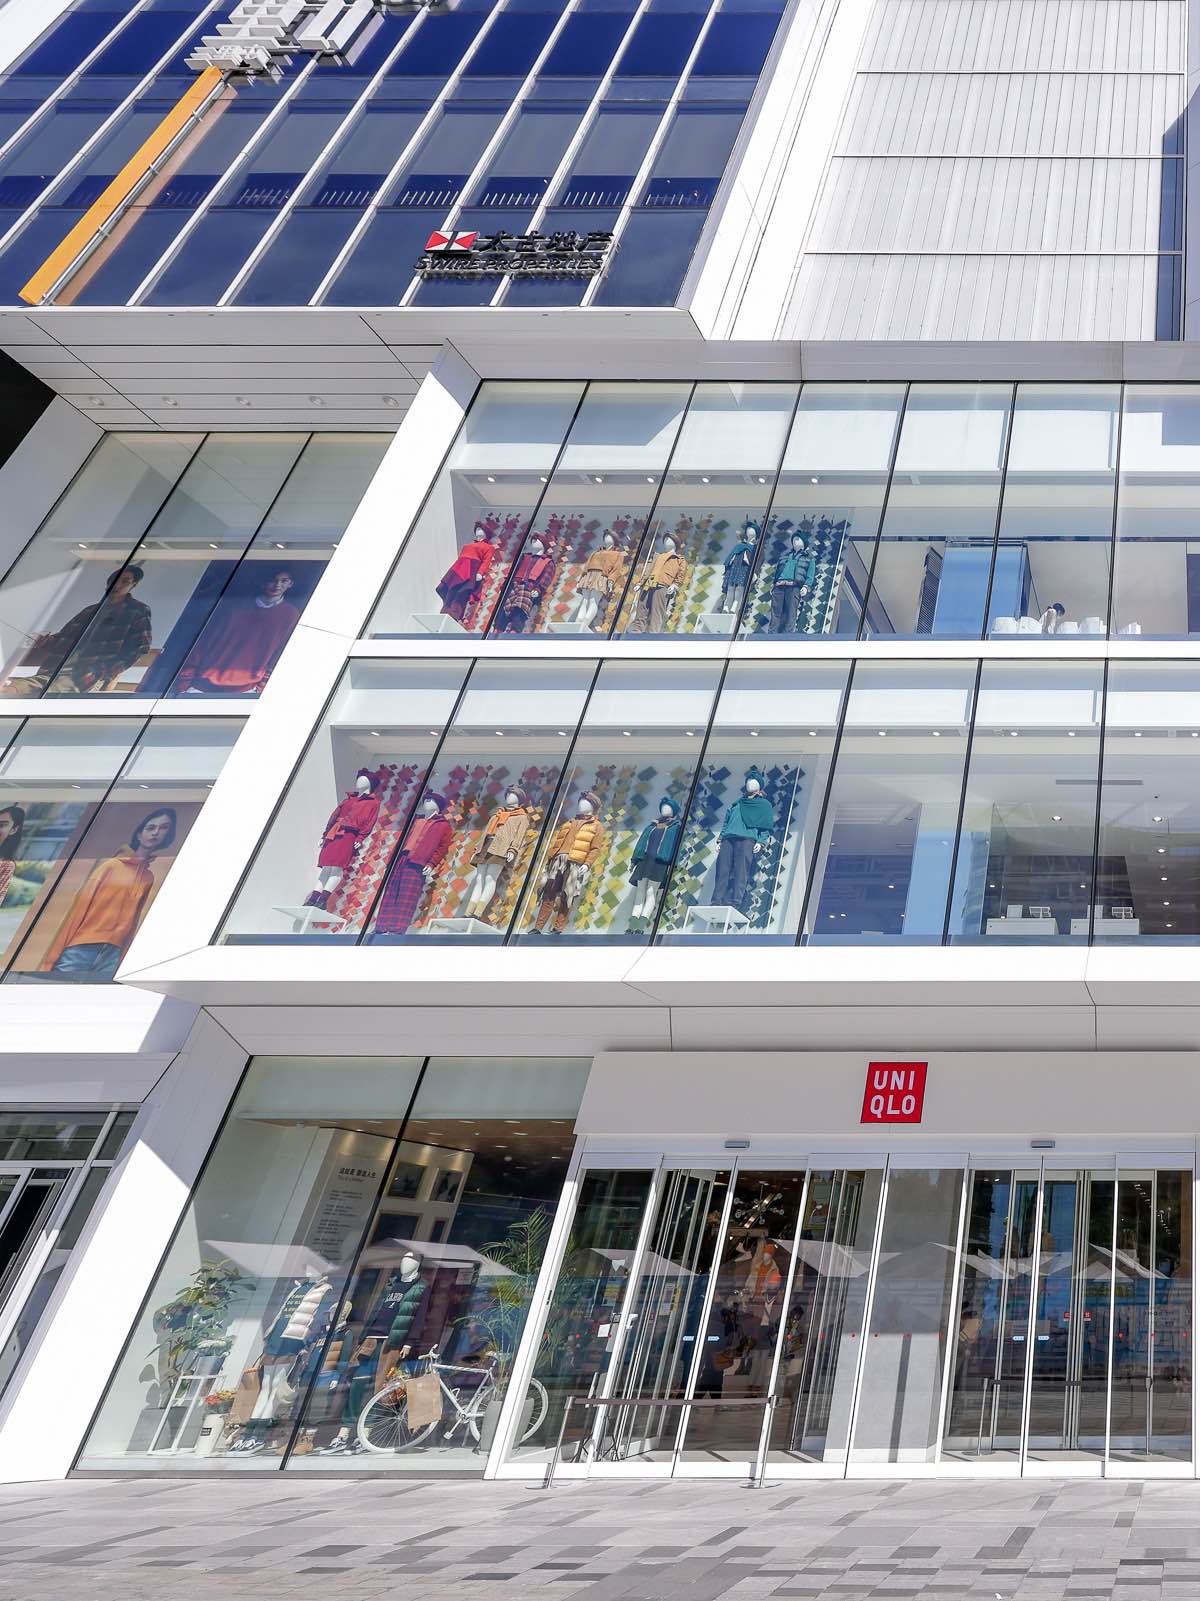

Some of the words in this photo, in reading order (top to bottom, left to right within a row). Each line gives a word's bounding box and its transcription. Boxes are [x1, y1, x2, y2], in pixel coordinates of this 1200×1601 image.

[414, 256, 481, 270] SWIRE
[482, 258, 604, 270] PROPERTIES
[873, 1070, 916, 1090] UNI
[870, 1094, 916, 1119] QLO
